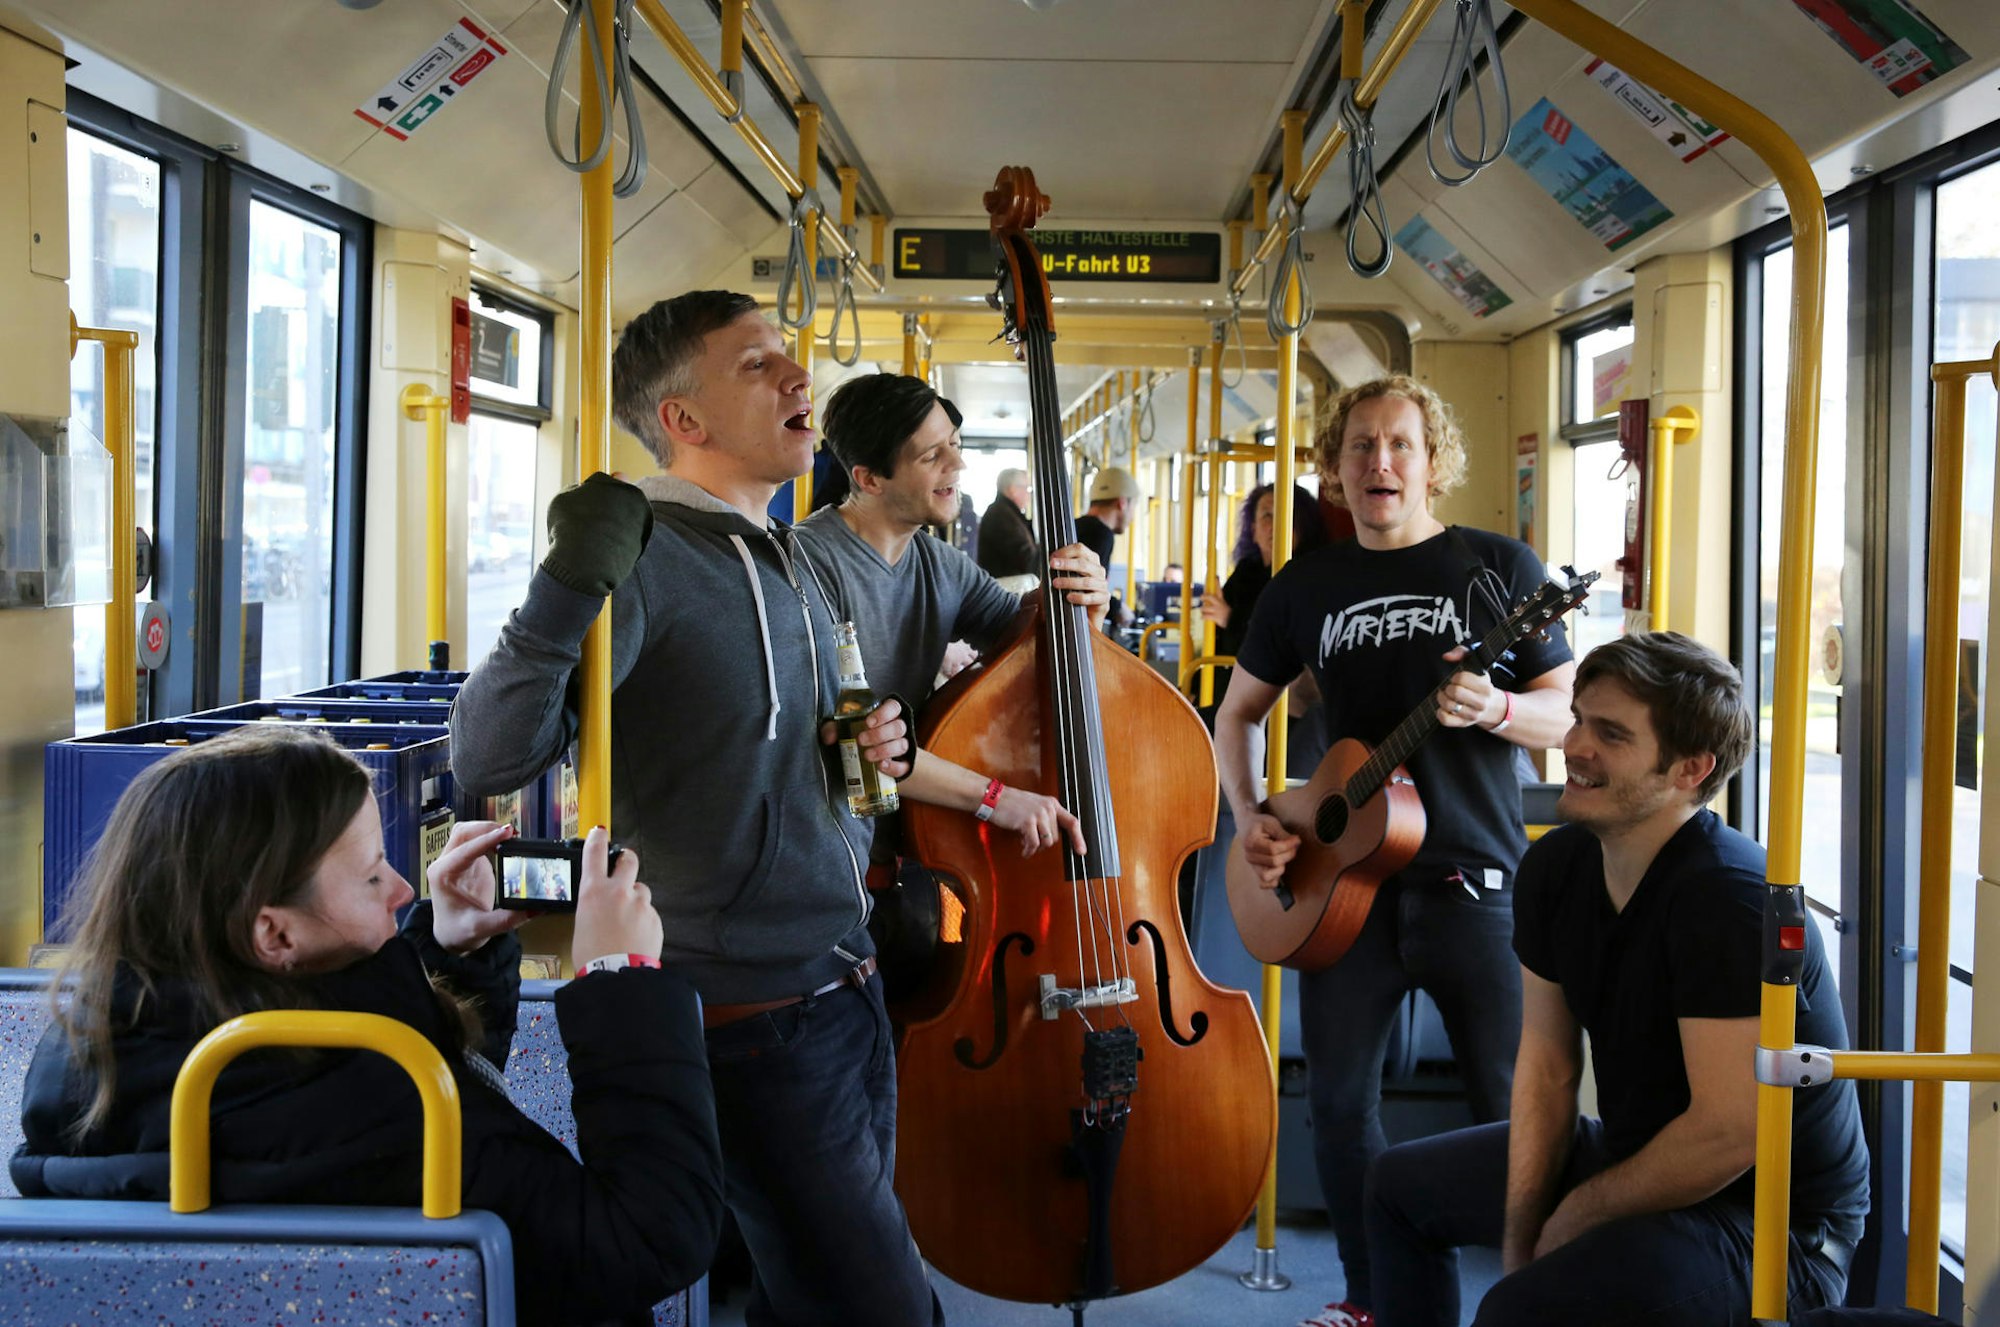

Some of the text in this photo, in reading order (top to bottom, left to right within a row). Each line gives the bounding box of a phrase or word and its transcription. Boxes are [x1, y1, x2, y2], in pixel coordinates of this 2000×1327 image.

[1082, 231, 1190, 247] HALTESTELLE
[901, 237, 921, 270] E
[1042, 254, 1151, 274] U-Fahrt U3
